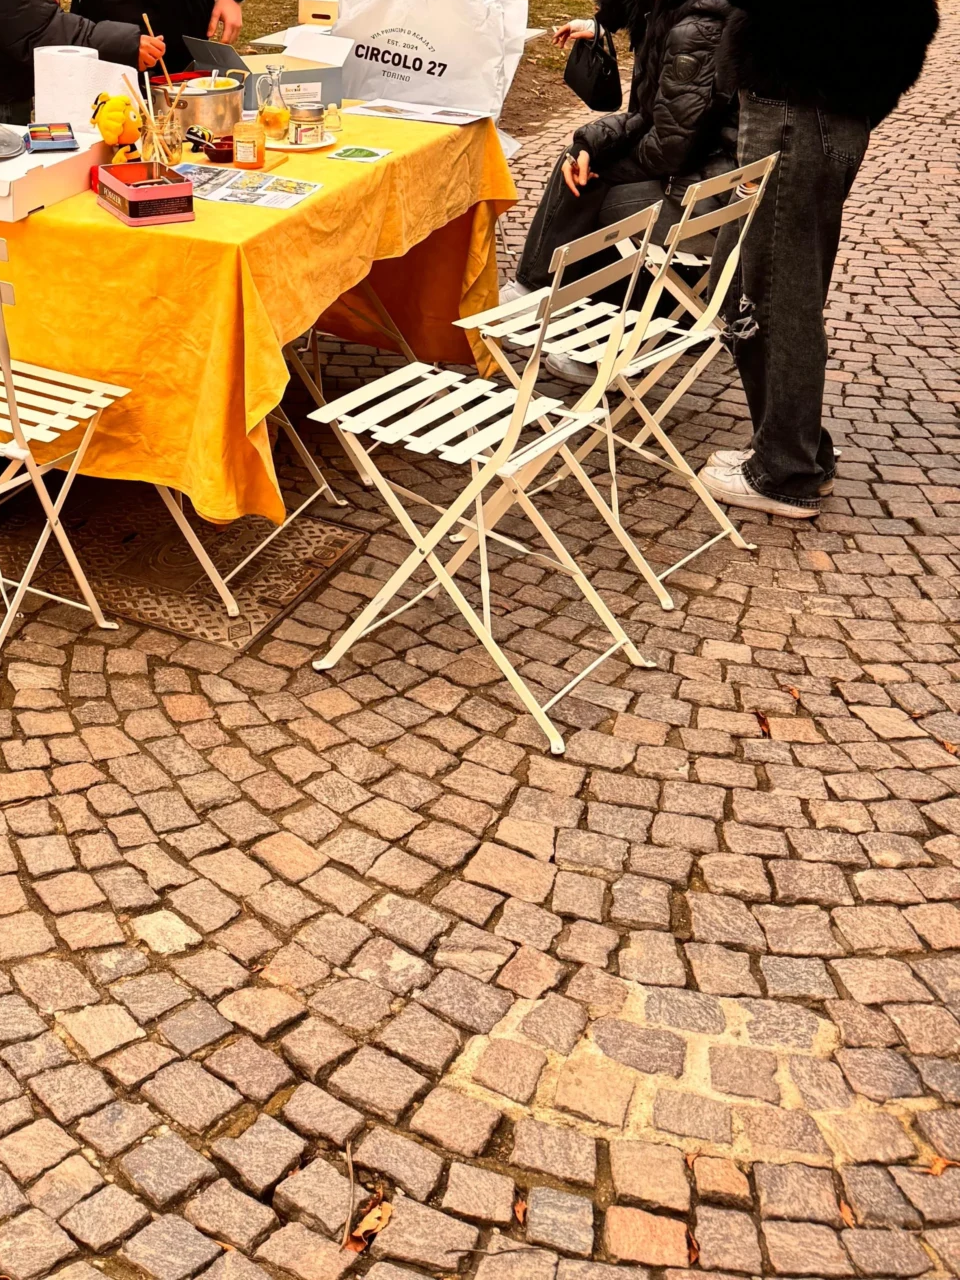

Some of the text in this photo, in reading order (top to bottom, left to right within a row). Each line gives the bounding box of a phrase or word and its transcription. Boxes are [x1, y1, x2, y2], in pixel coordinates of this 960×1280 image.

[387, 38, 400, 47] EST.
[354, 44, 447, 77] CIRCOLO 27
[381, 69, 411, 82] TORINO
